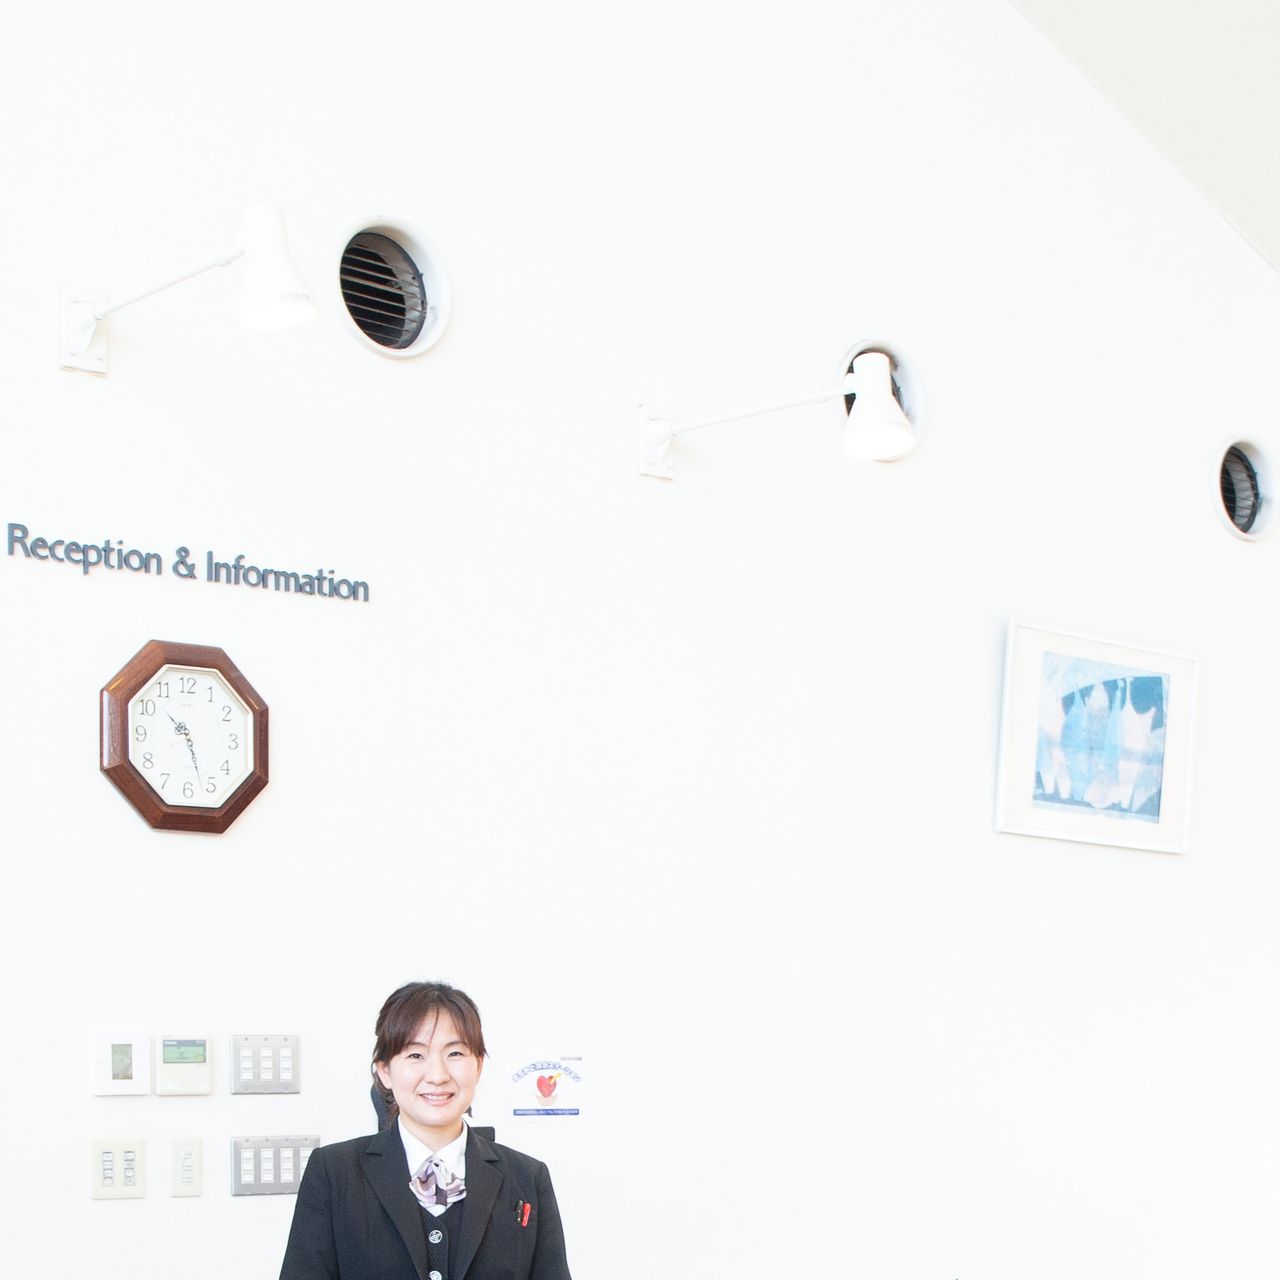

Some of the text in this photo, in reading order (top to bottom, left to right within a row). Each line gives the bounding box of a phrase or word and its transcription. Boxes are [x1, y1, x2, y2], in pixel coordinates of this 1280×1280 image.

[7, 523, 370, 603] Reception & Information
[155, 681, 171, 698] 11
[179, 677, 196, 695] 12
[207, 686, 214, 703] 1
[139, 699, 156, 716] 10
[222, 706, 232, 723] 2
[135, 725, 147, 742] 9
[228, 733, 239, 750] 3
[142, 752, 154, 770] 8
[220, 760, 231, 775] 4
[160, 773, 170, 791] 7
[182, 781, 194, 799] 6
[205, 777, 216, 794] 5
